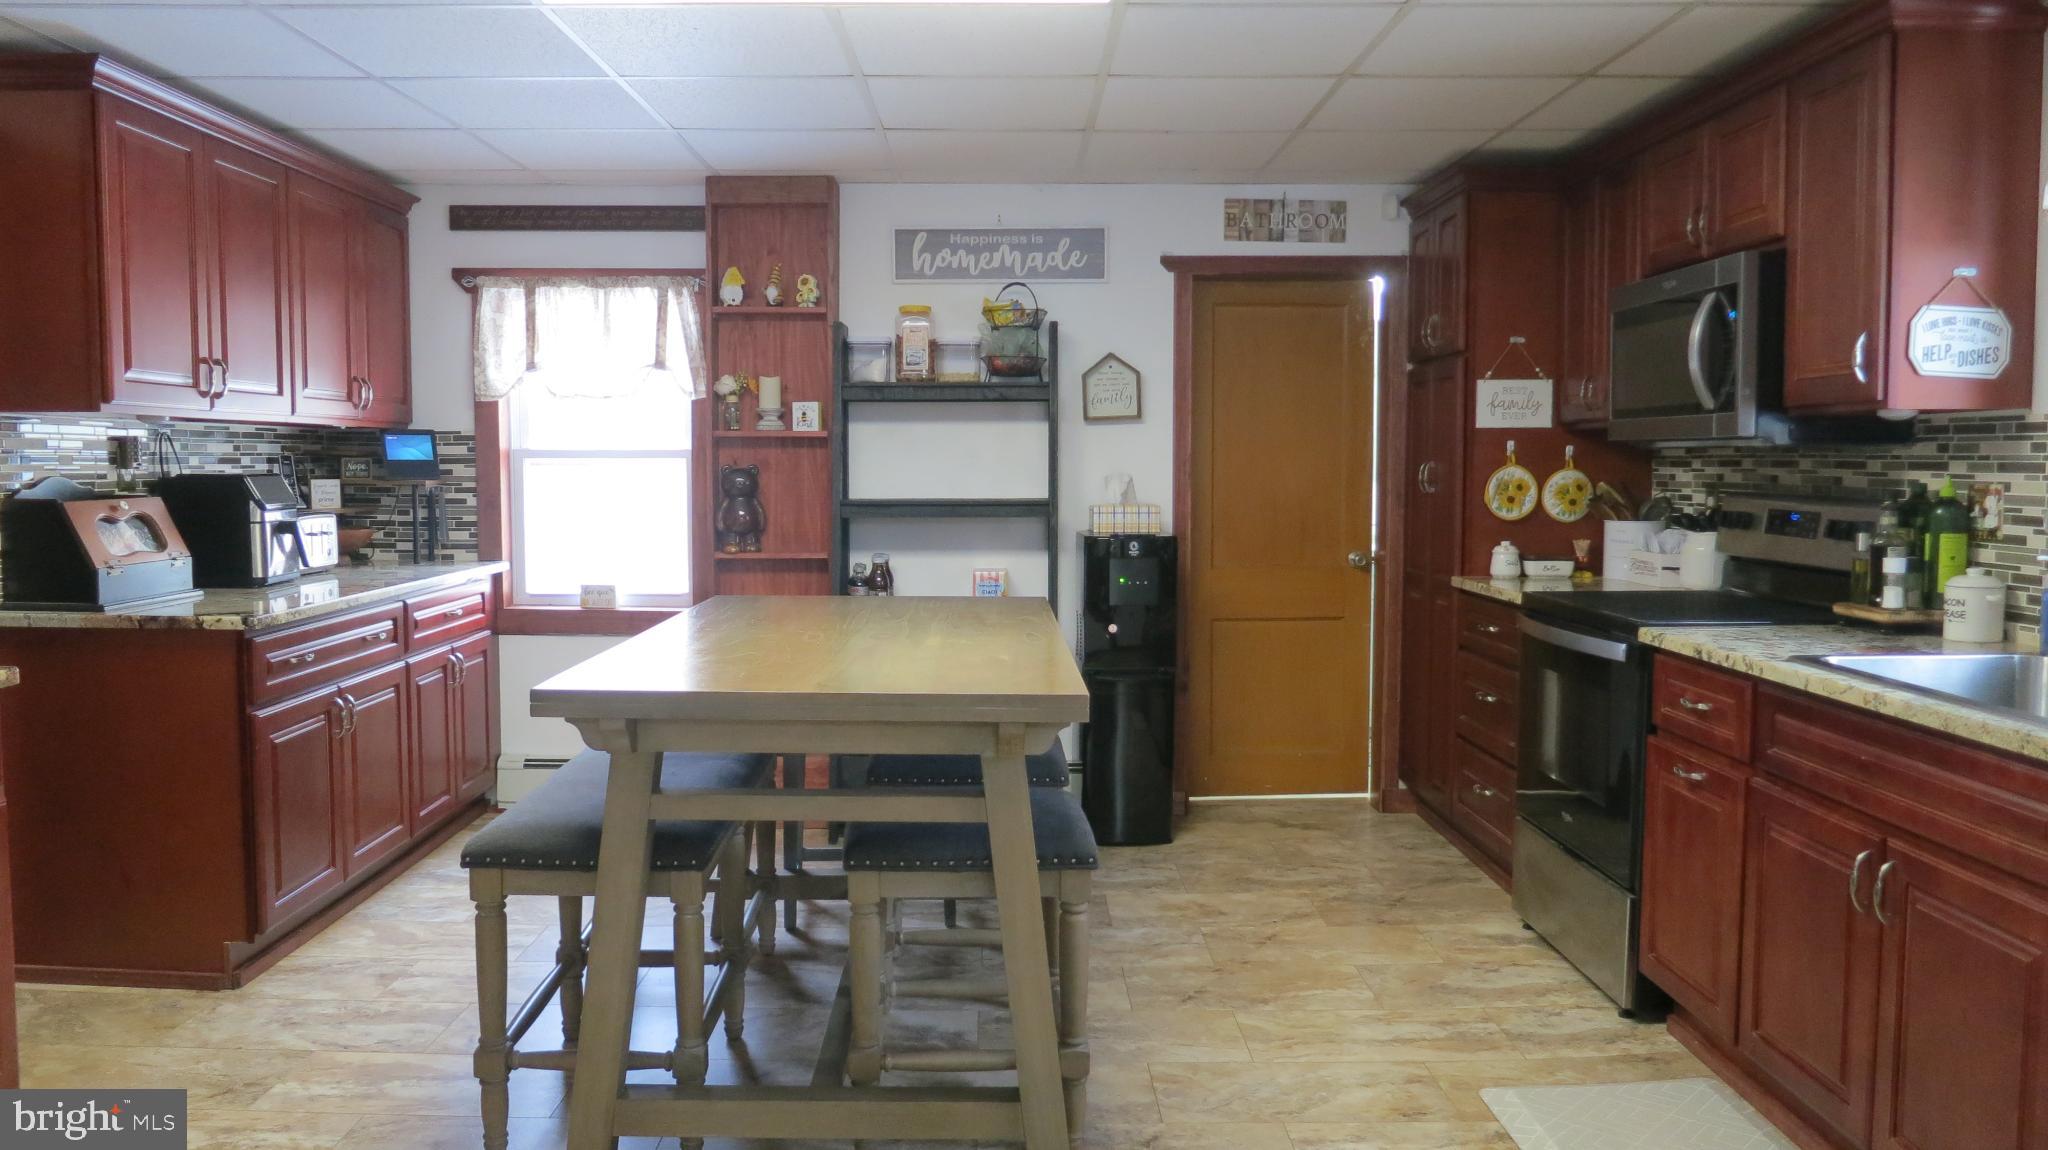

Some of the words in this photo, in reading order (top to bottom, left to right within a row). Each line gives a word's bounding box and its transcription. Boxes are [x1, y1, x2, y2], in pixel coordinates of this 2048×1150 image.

[1226, 211, 1345, 229] BATHROOM
[949, 233, 1027, 246] Happiness
[1031, 233, 1044, 244] is
[912, 231, 1088, 276] homemade
[1921, 343, 1952, 363] HELP
[1957, 346, 2000, 368] DISHES
[1503, 386, 1528, 395] BEST
[1487, 390, 1542, 416] family
[1501, 411, 1528, 420] EVER
[1944, 609, 1967, 619] EASE
